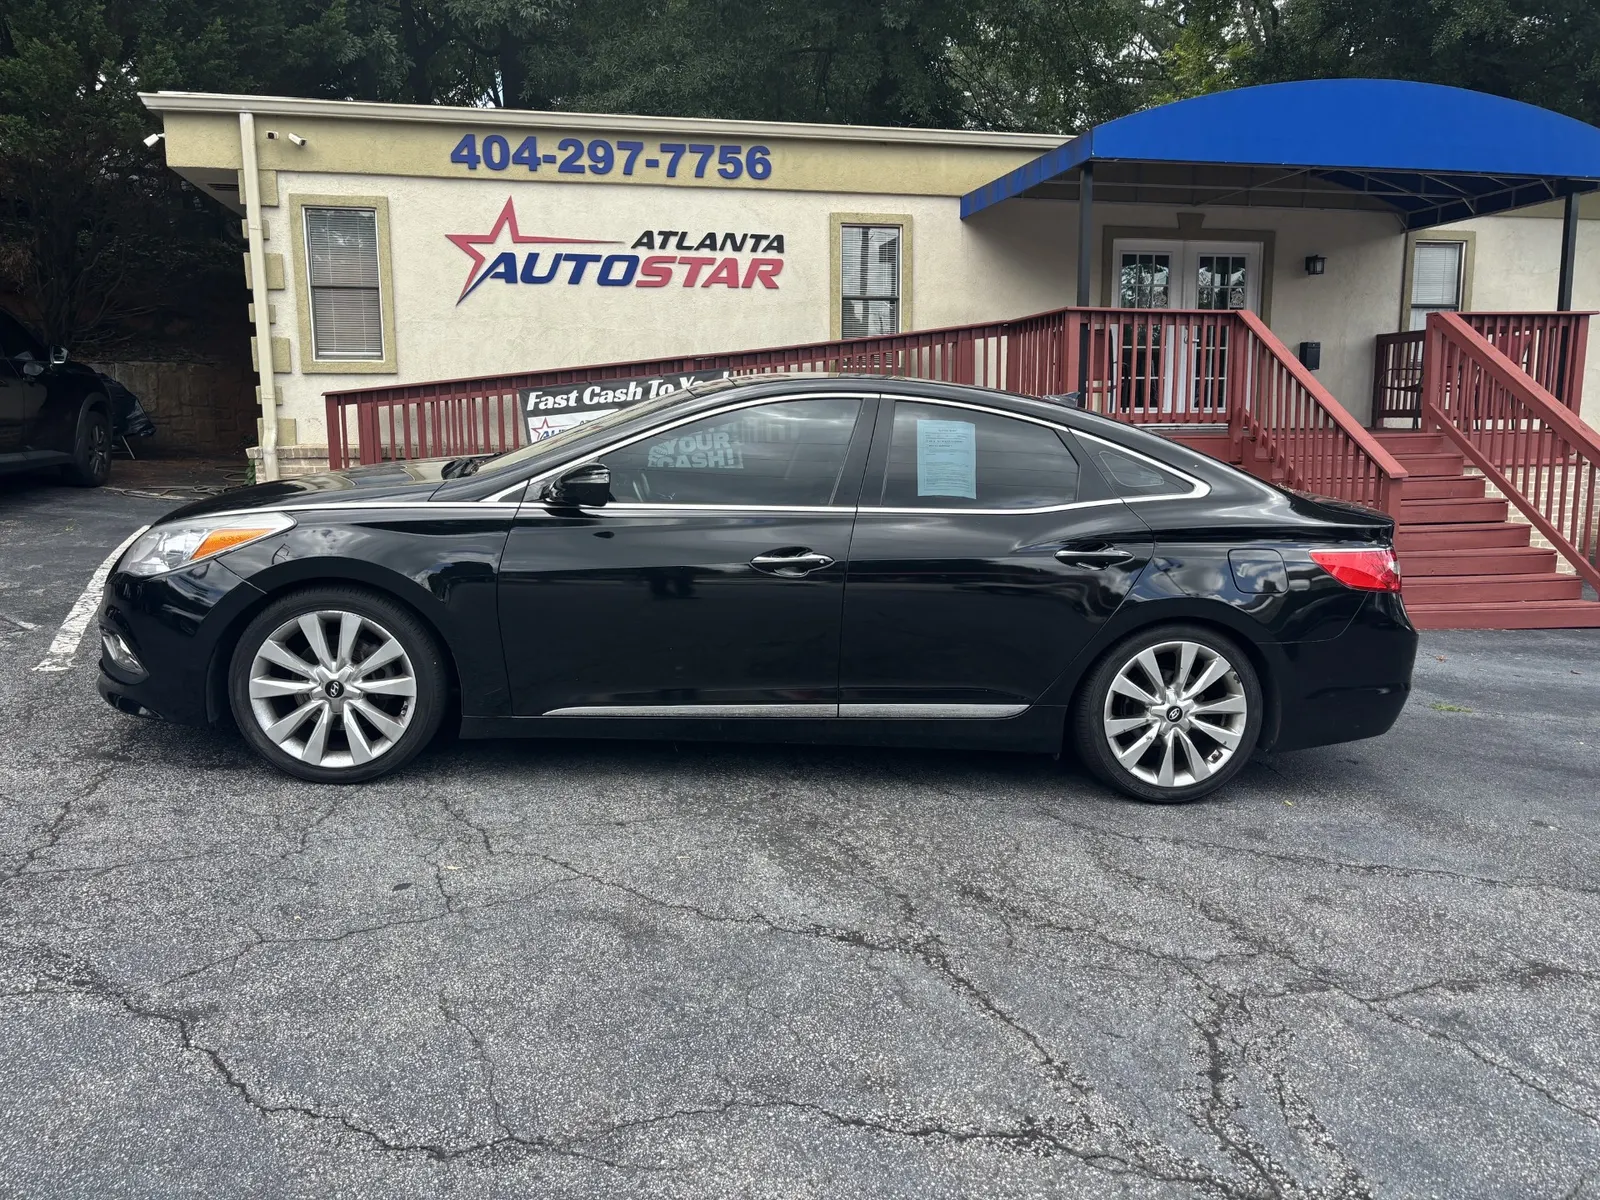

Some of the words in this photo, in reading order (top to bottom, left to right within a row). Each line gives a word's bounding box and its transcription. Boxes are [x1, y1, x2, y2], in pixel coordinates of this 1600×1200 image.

[451, 133, 772, 180] 404-297-7756
[631, 230, 785, 254] ATLANTA
[526, 390, 579, 411] Fast
[583, 381, 643, 405] Cash
[648, 380, 675, 399] To
[663, 432, 731, 455] YOUR
